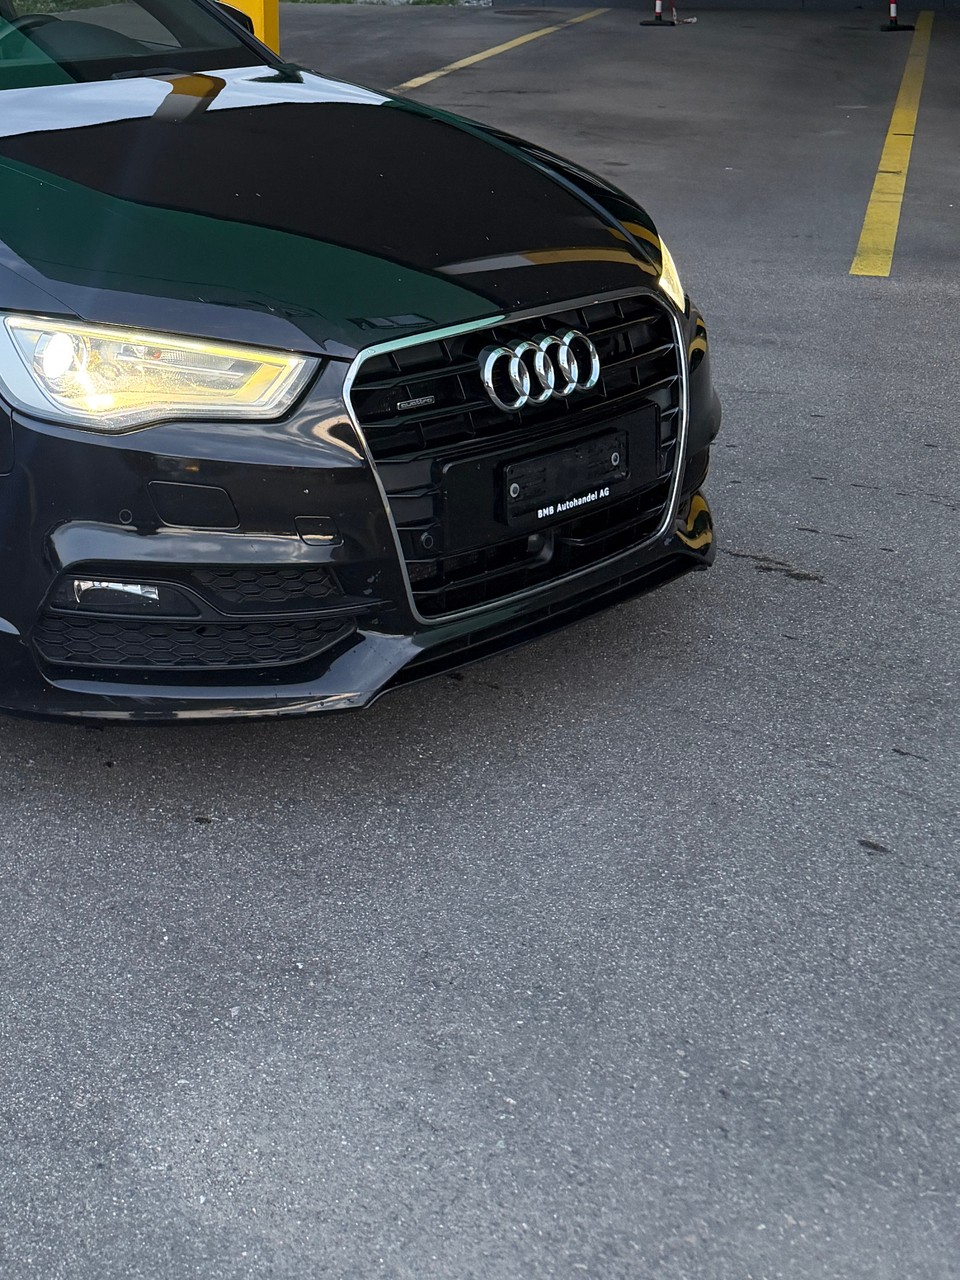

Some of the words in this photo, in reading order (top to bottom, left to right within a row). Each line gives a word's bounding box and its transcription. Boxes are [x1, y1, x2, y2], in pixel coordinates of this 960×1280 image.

[537, 505, 555, 519] BMB
[556, 490, 598, 513] Autohandel
[599, 487, 610, 498] AG
